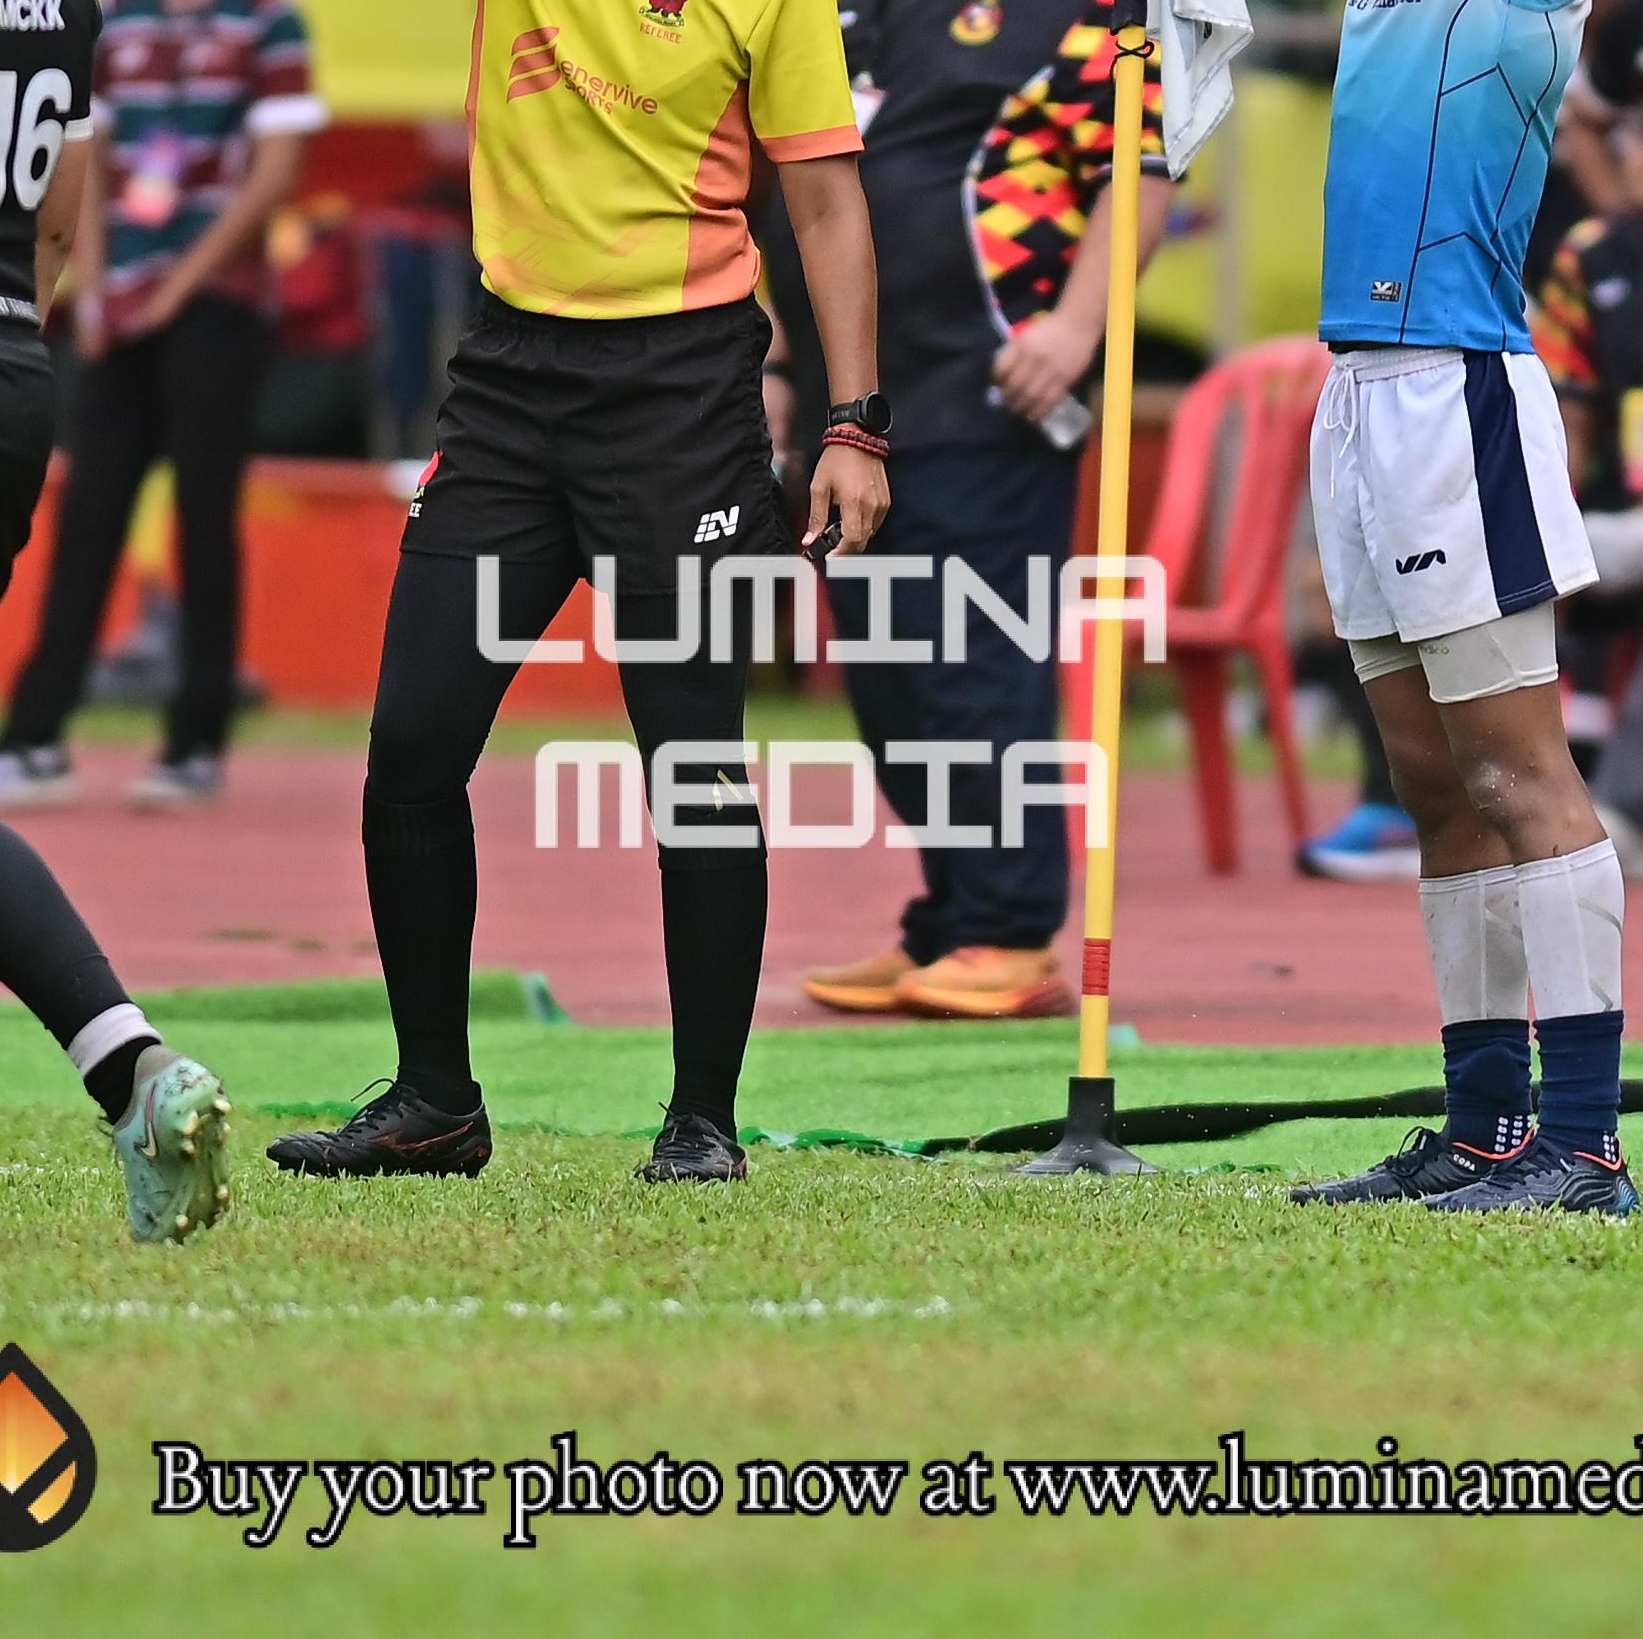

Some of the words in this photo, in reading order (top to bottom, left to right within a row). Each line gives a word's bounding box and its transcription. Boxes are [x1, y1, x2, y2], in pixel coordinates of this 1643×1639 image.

[640, 22, 683, 44] REFEREE
[559, 58, 659, 116] enervive
[564, 77, 615, 116] SPORTS
[1452, 1152, 1477, 1173] COPA
